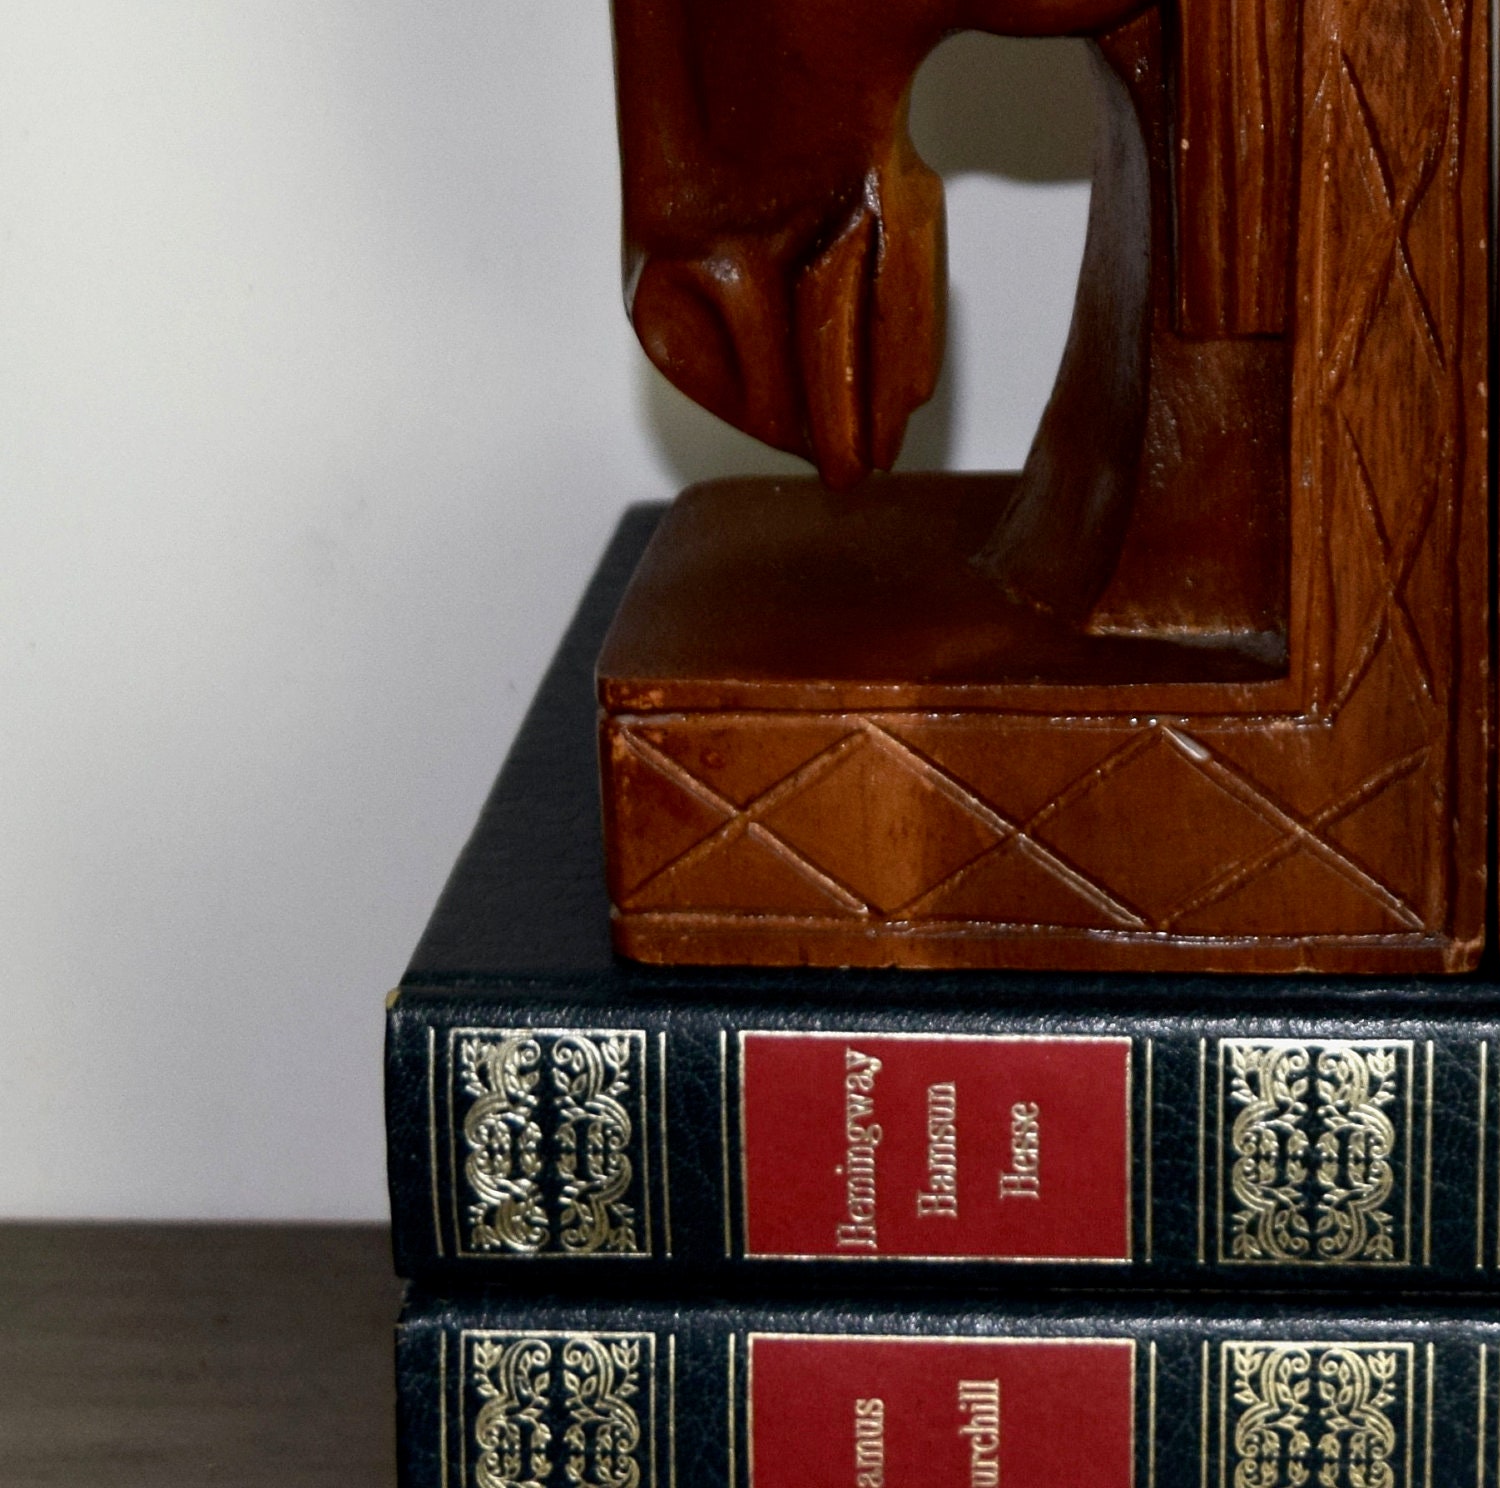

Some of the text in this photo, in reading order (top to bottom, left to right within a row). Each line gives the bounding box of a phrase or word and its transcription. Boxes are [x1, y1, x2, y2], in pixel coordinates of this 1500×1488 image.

[836, 1047, 882, 1248] Hemingway
[917, 1082, 957, 1216] Hamsun
[1000, 1102, 1039, 1198] Hesse
